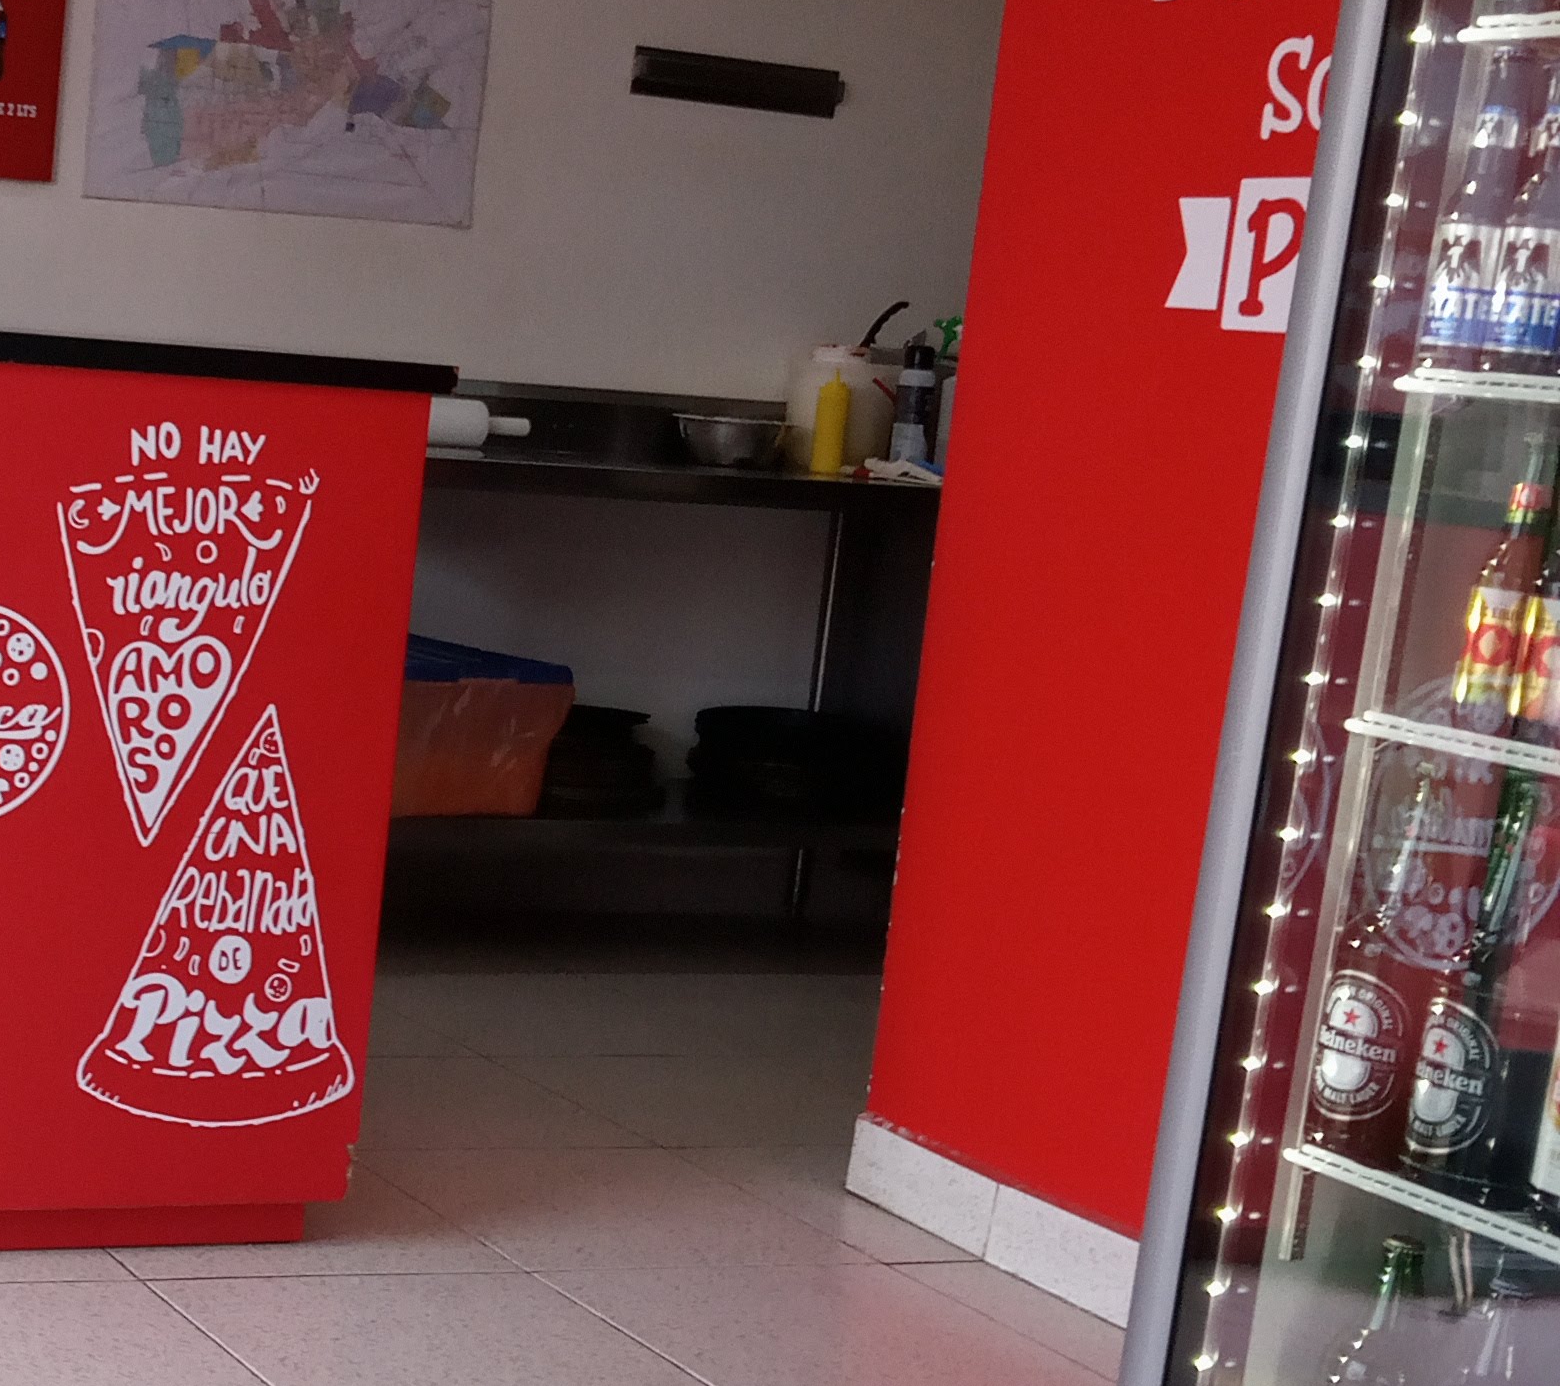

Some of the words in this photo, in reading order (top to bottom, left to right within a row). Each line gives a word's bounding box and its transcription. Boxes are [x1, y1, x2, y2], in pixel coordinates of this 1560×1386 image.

[130, 421, 181, 466] NO
[199, 425, 267, 465] HAY
[223, 765, 291, 815] QUE
[204, 813, 298, 862] UNA
[218, 947, 242, 972] DE
[115, 972, 336, 1075] Pizza
